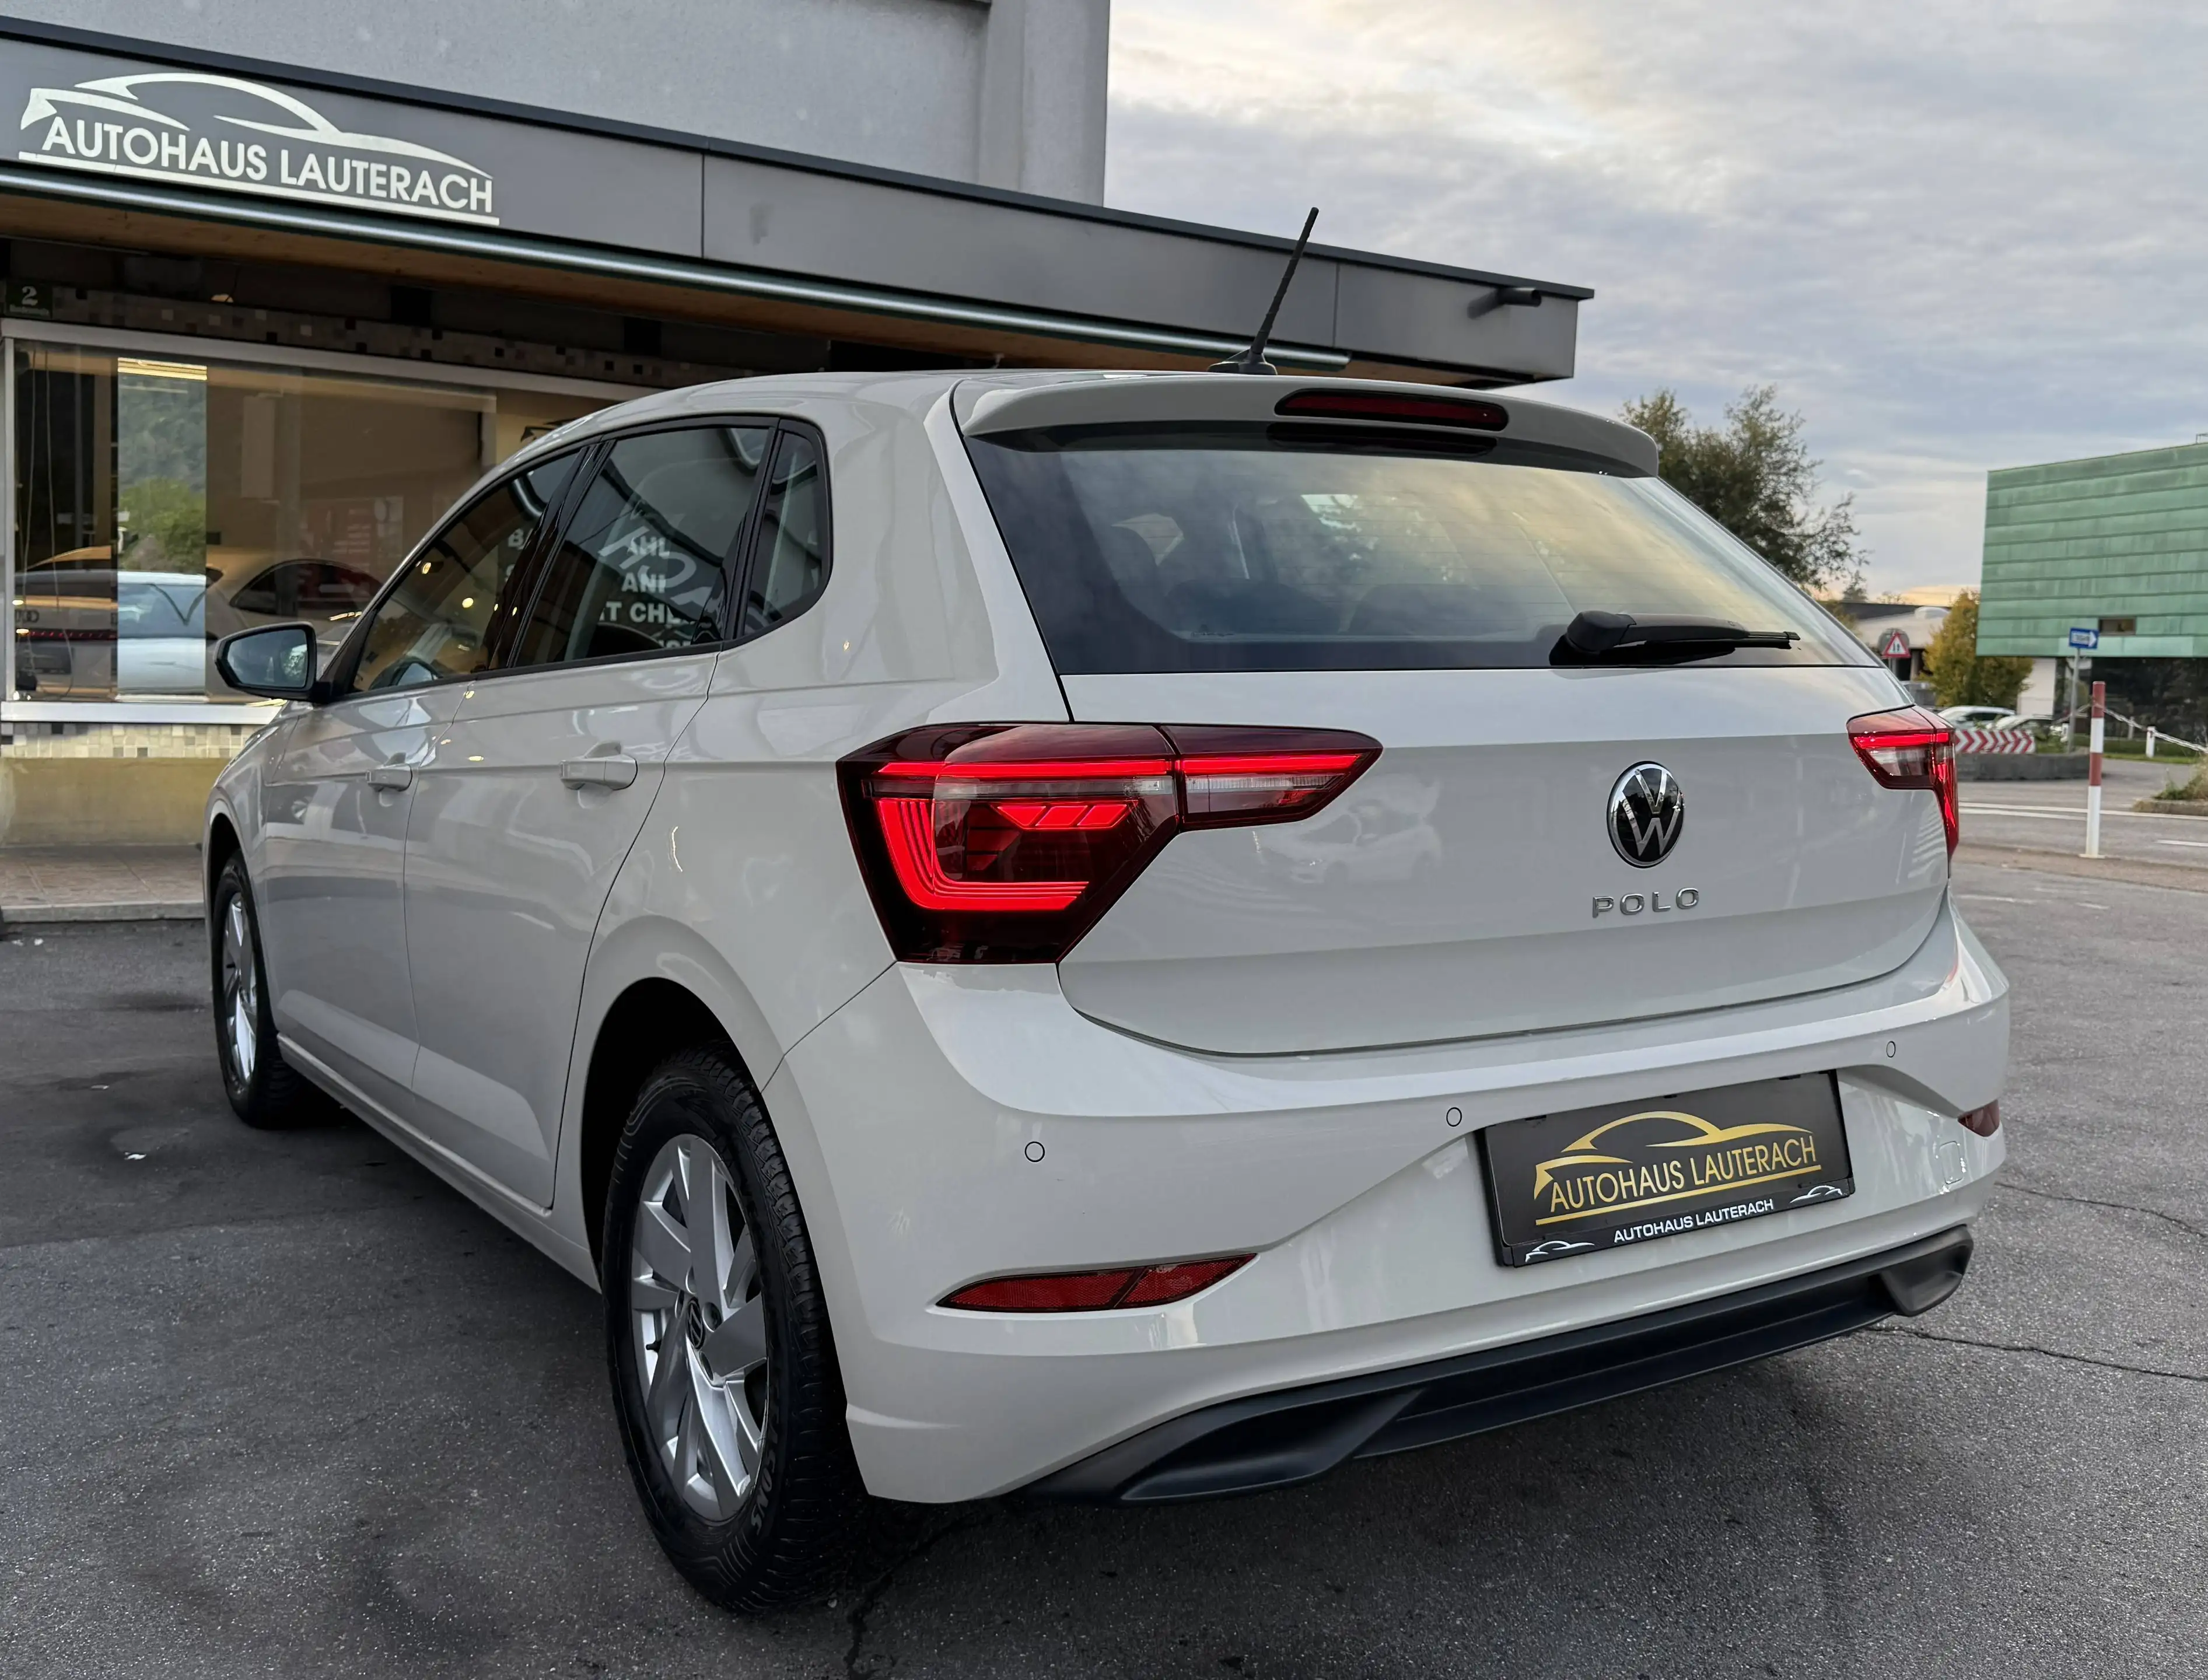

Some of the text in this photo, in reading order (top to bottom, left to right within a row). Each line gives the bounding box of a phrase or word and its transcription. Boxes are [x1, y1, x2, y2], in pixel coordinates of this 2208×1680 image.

[41, 116, 492, 213] AUTOHAUS LAUTERACH
[22, 286, 38, 306] 2
[1592, 887, 1699, 918] POLO
[1551, 1136, 1817, 1213] AUTOHAUS LAUTERACH
[1614, 1199, 1774, 1243] AUTOHAUS LAUTERACH
